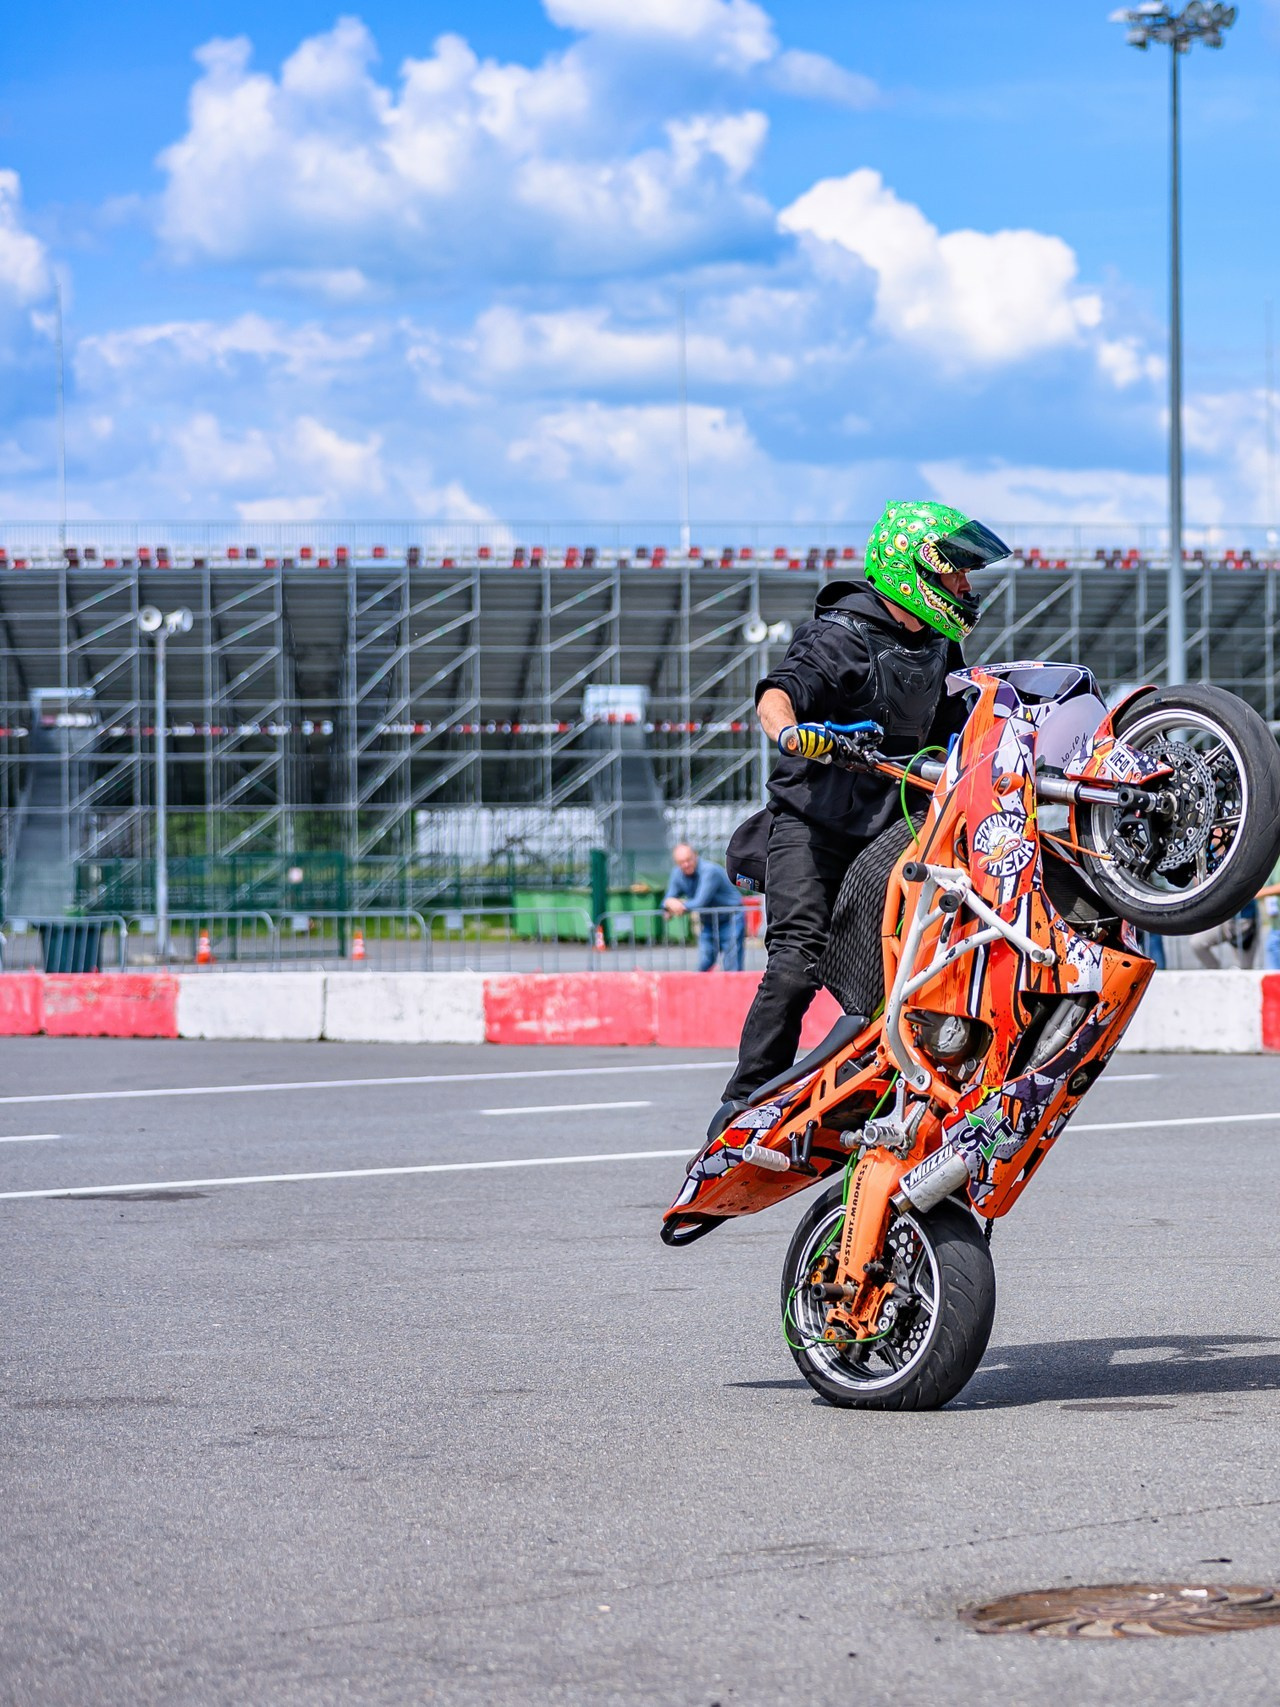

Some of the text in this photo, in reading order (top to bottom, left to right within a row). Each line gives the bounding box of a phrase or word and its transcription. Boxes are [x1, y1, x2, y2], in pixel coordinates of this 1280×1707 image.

[974, 813, 1025, 853] STUNT
[989, 841, 1036, 875] TECH
[958, 1114, 1014, 1153] SMT
[844, 1163, 869, 1267] @STUNT.MADNESS
